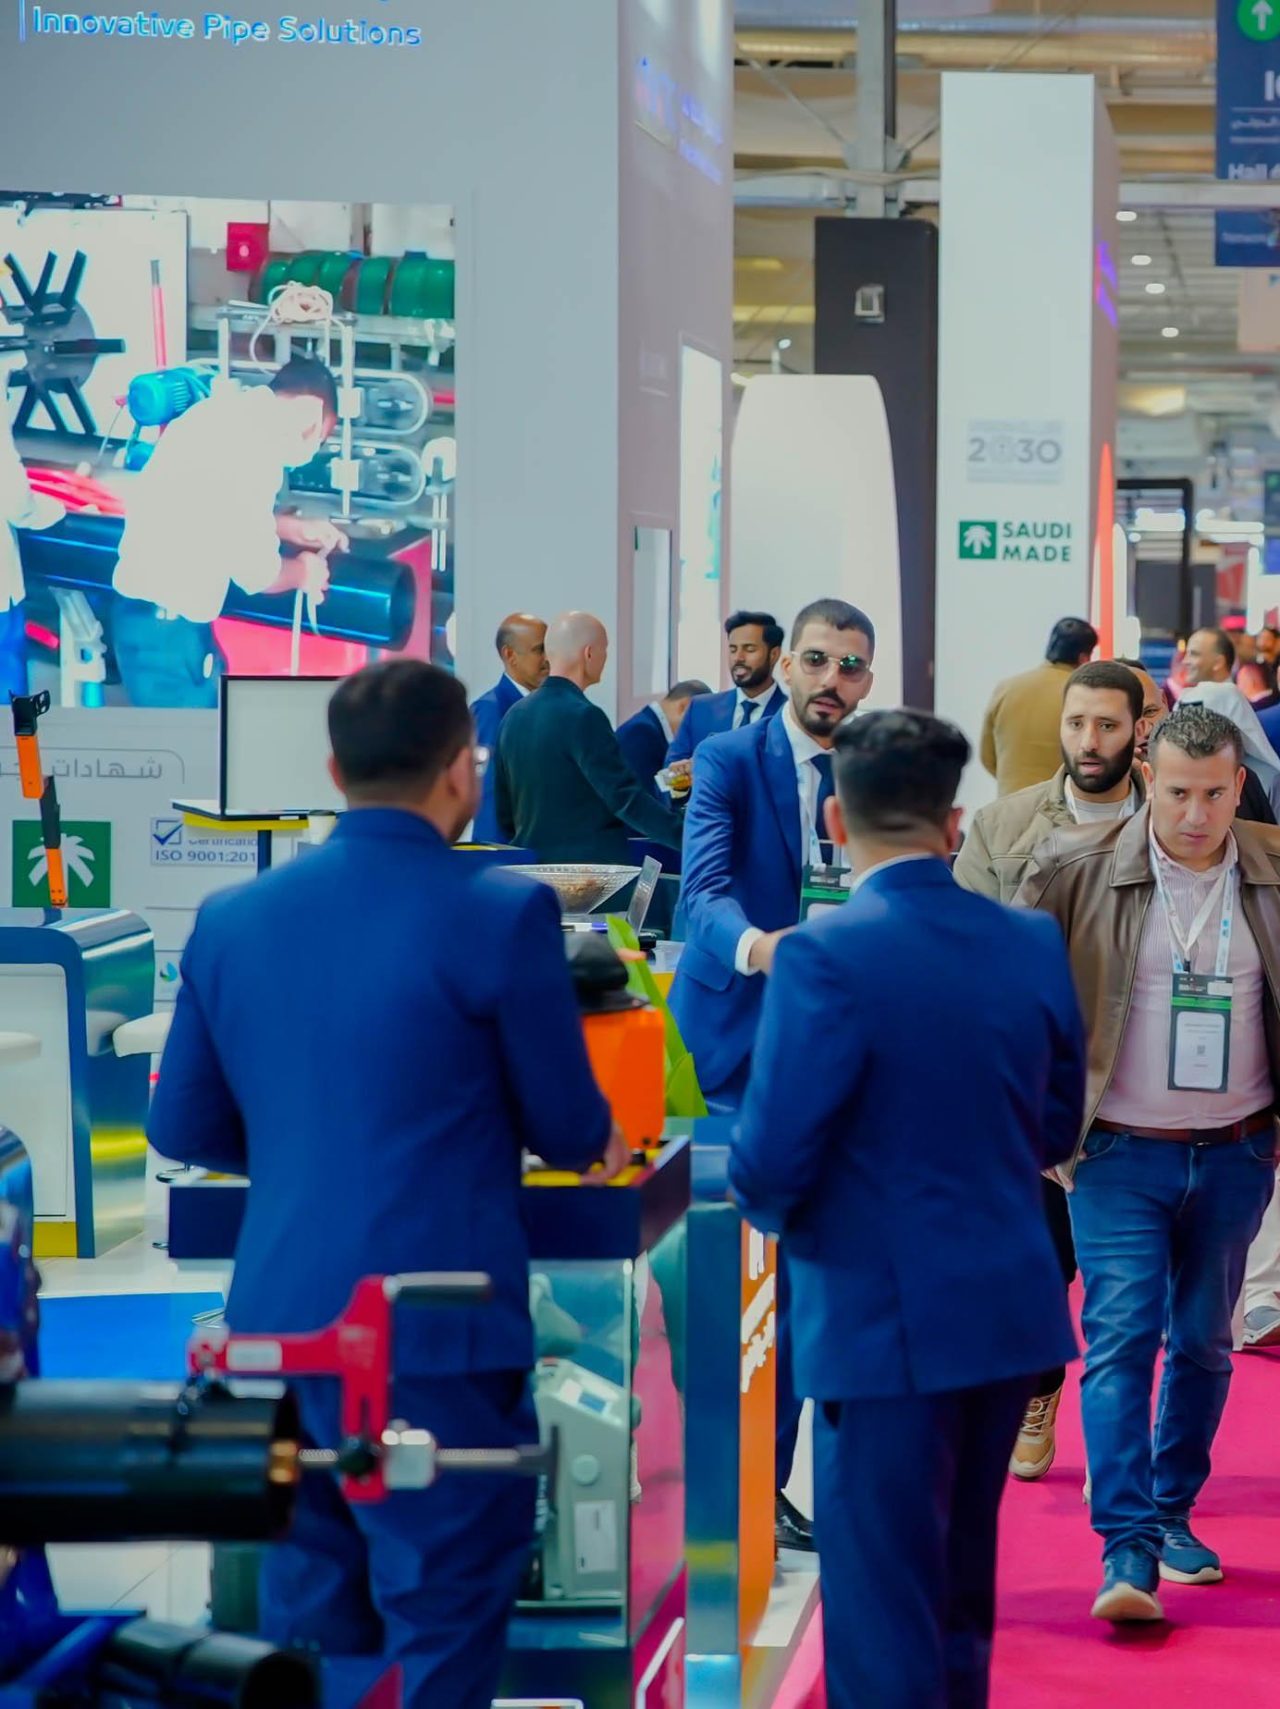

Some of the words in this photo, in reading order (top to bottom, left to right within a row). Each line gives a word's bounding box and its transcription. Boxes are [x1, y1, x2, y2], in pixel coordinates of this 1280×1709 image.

[33, 6, 195, 38] Innovative
[203, 13, 269, 46] Pipe
[278, 16, 422, 46] Solutions
[1002, 522, 1072, 539] SAUDI
[1002, 545, 1071, 562] MADE
[155, 849, 183, 861] ISO
